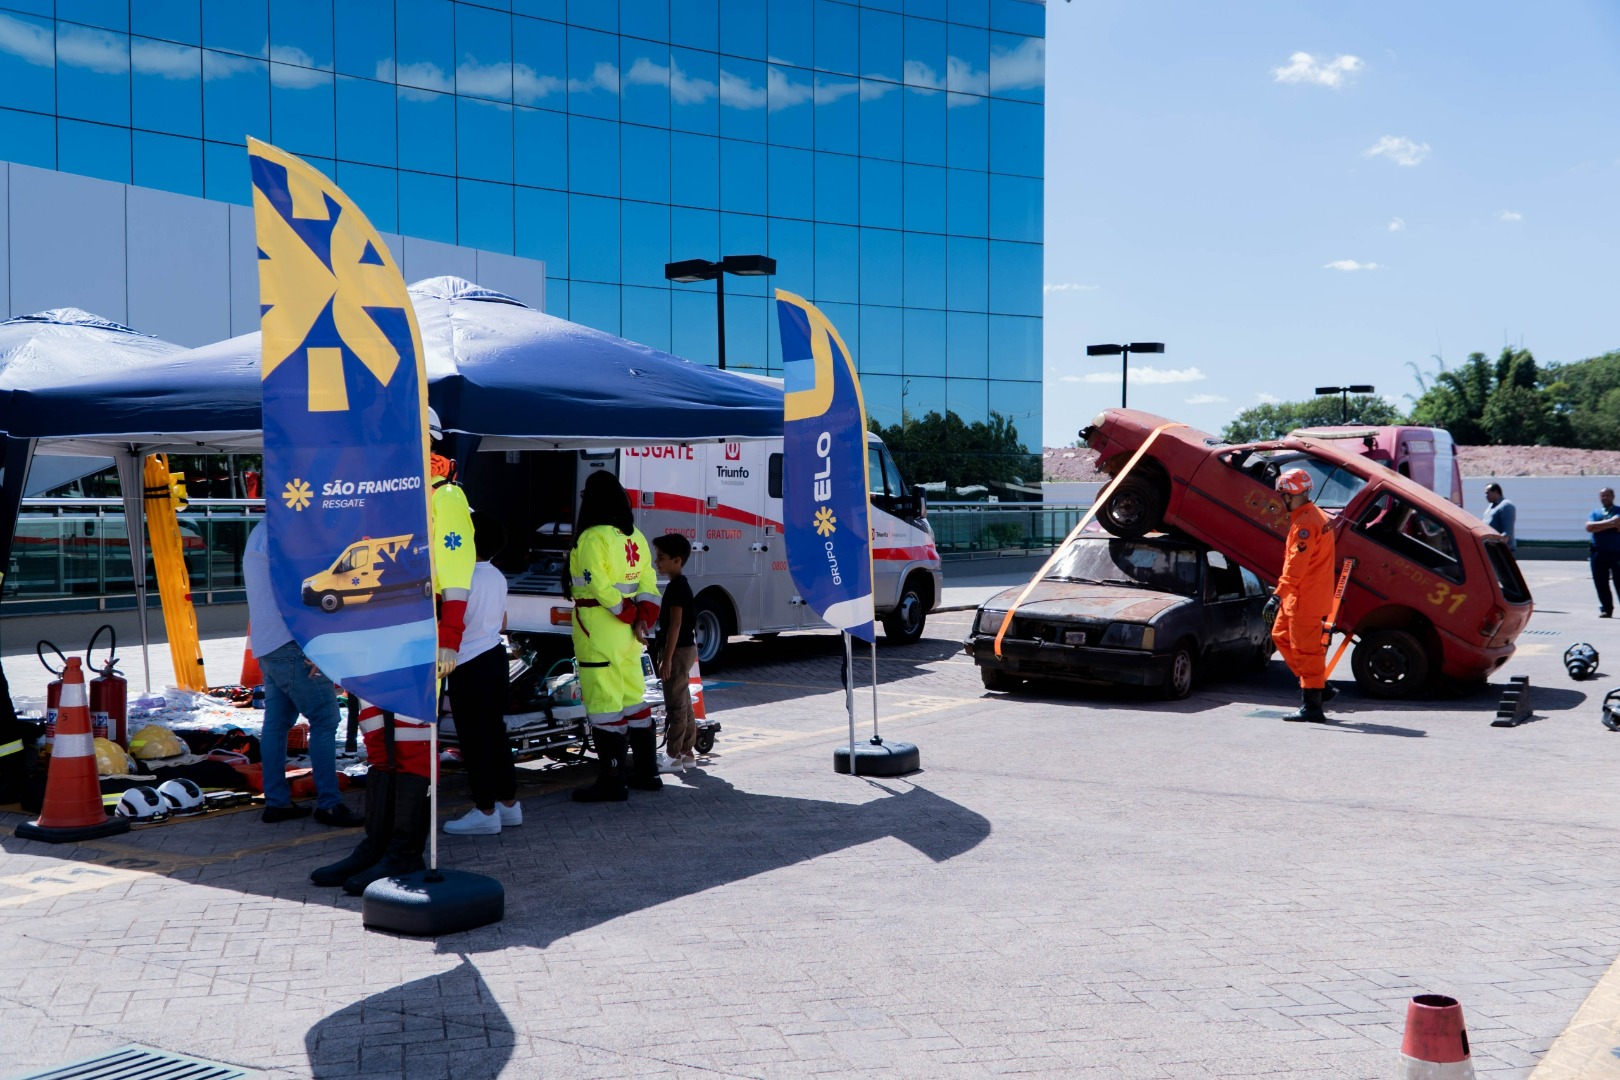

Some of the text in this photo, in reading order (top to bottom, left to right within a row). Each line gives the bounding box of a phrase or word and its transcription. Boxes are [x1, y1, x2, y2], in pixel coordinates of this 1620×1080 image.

[716, 465, 750, 479] Triunfo
[321, 479, 355, 496] SÃO
[322, 498, 366, 509] RESGATE
[813, 431, 842, 586] GRUPO ELO
[706, 528, 742, 540] GRATUITO
[1426, 582, 1468, 615] 31
